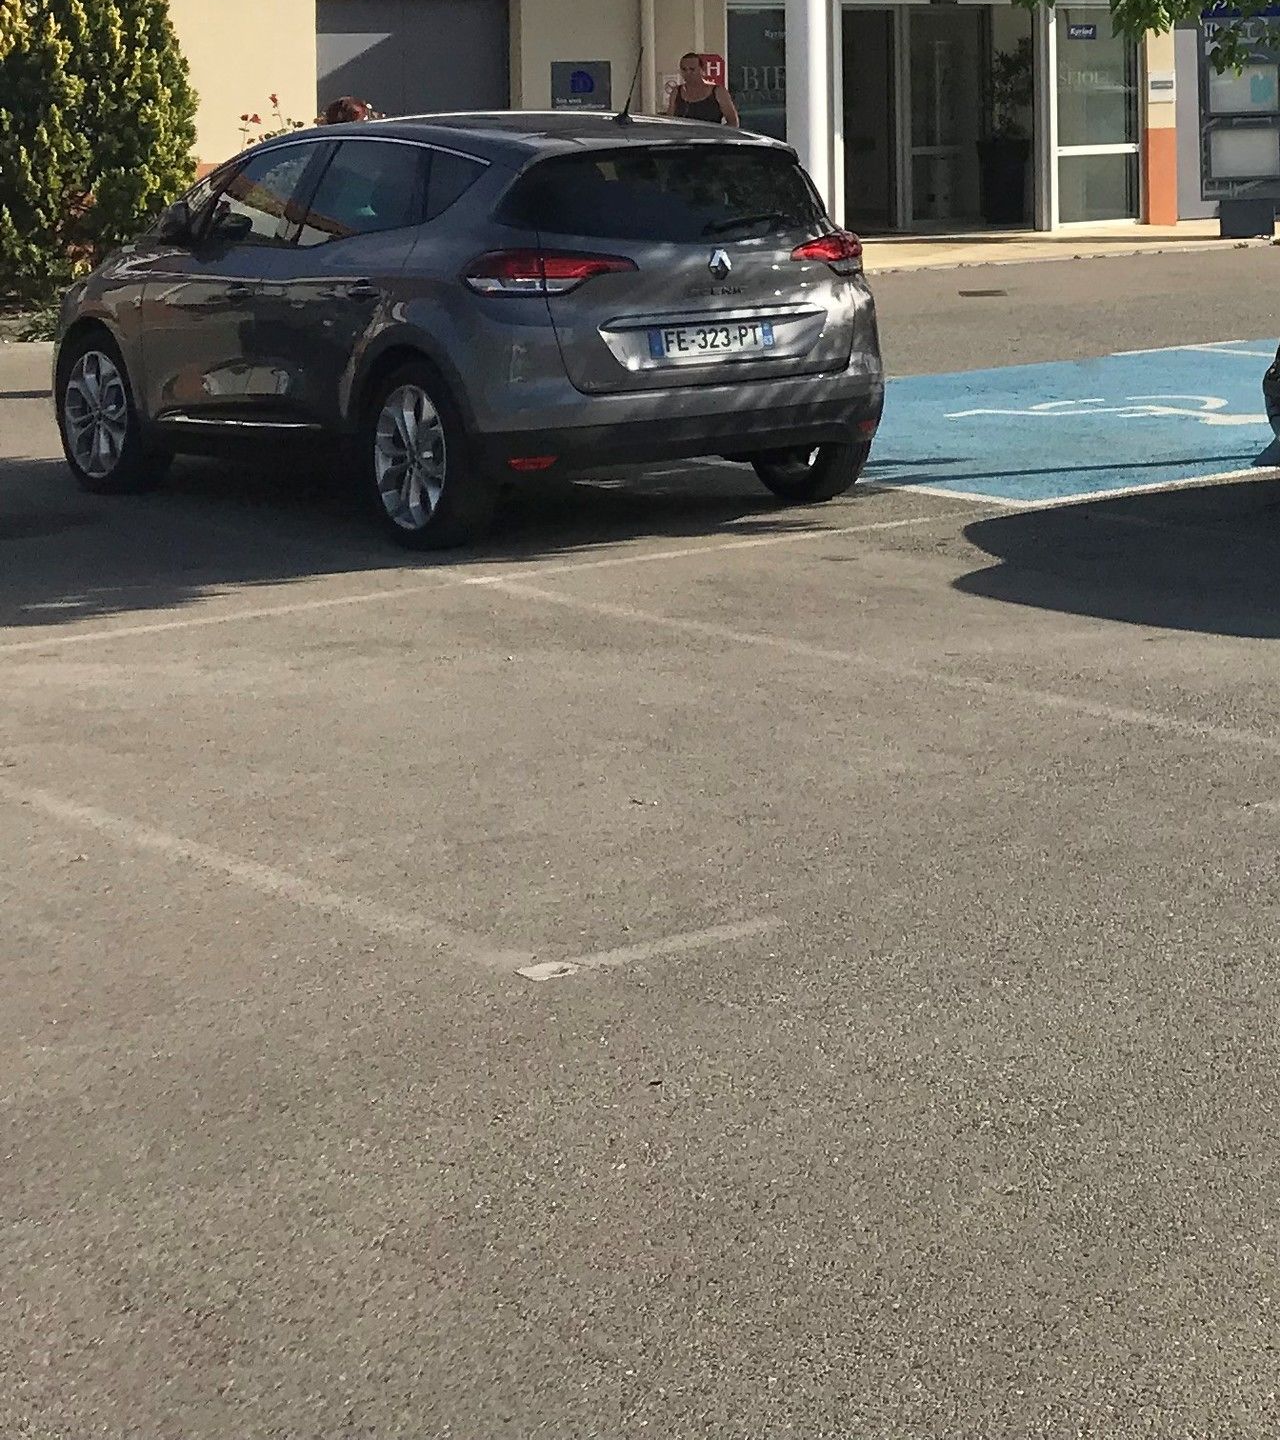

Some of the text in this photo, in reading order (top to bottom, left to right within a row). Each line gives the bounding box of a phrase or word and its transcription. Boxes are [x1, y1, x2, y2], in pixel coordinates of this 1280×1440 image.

[1070, 27, 1094, 37] Kyriad
[706, 61, 721, 77] H
[664, 324, 759, 353] FE-323-PT
